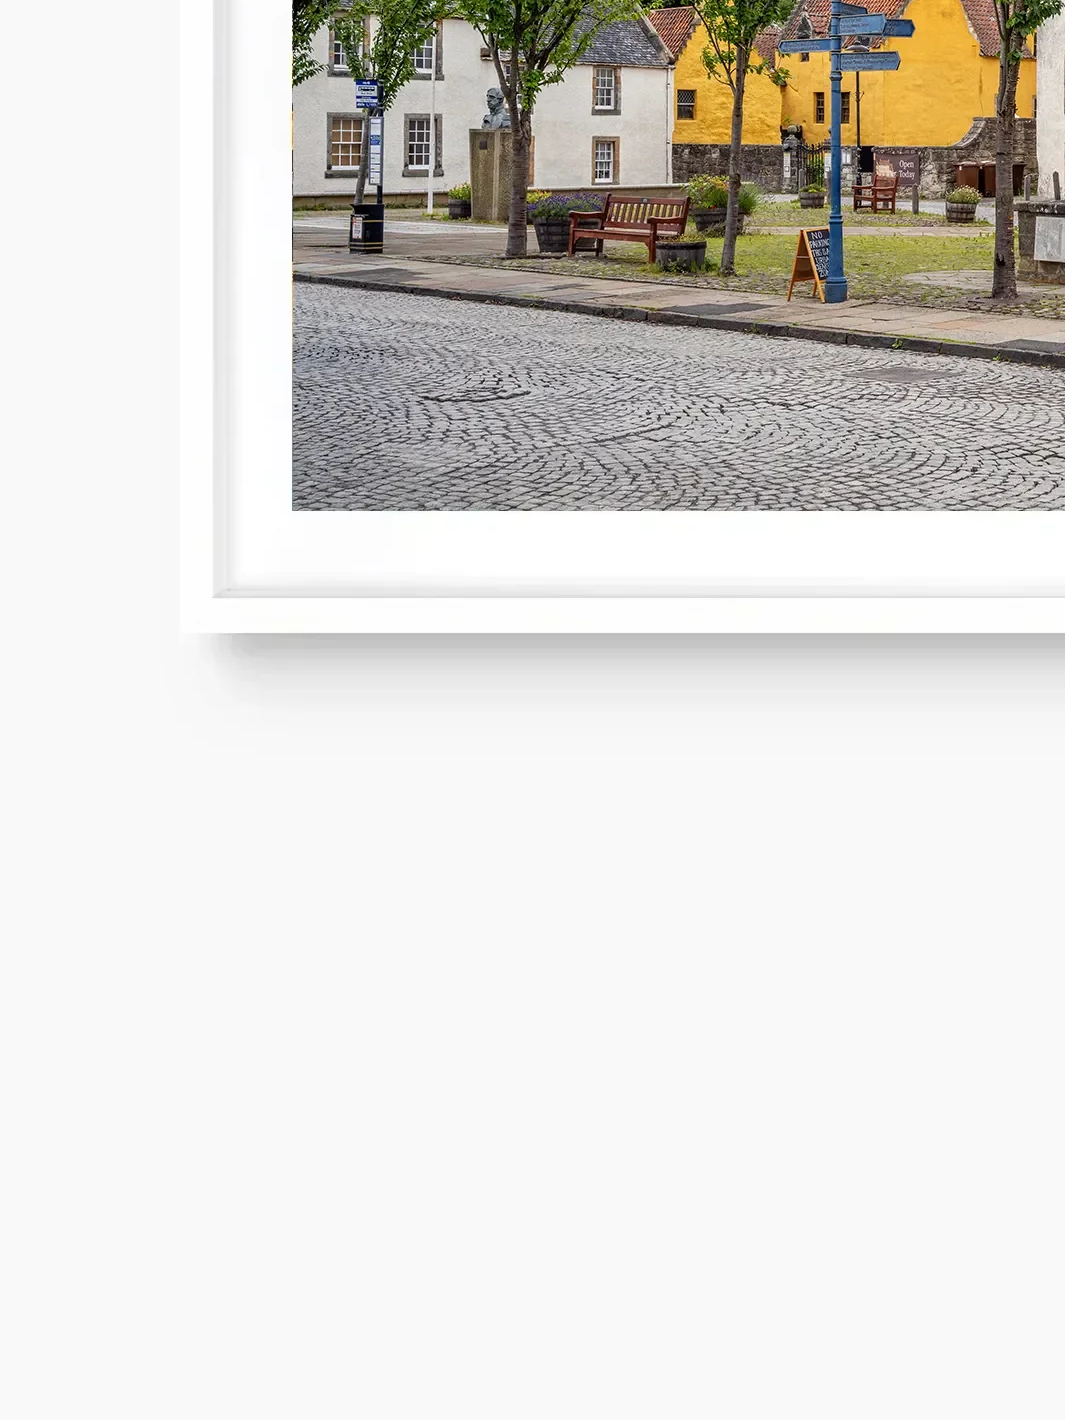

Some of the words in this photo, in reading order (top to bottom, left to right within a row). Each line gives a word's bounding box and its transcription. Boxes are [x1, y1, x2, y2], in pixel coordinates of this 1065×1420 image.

[899, 159, 914, 170] Open
[899, 170, 915, 180] Today
[811, 231, 823, 240] NO
